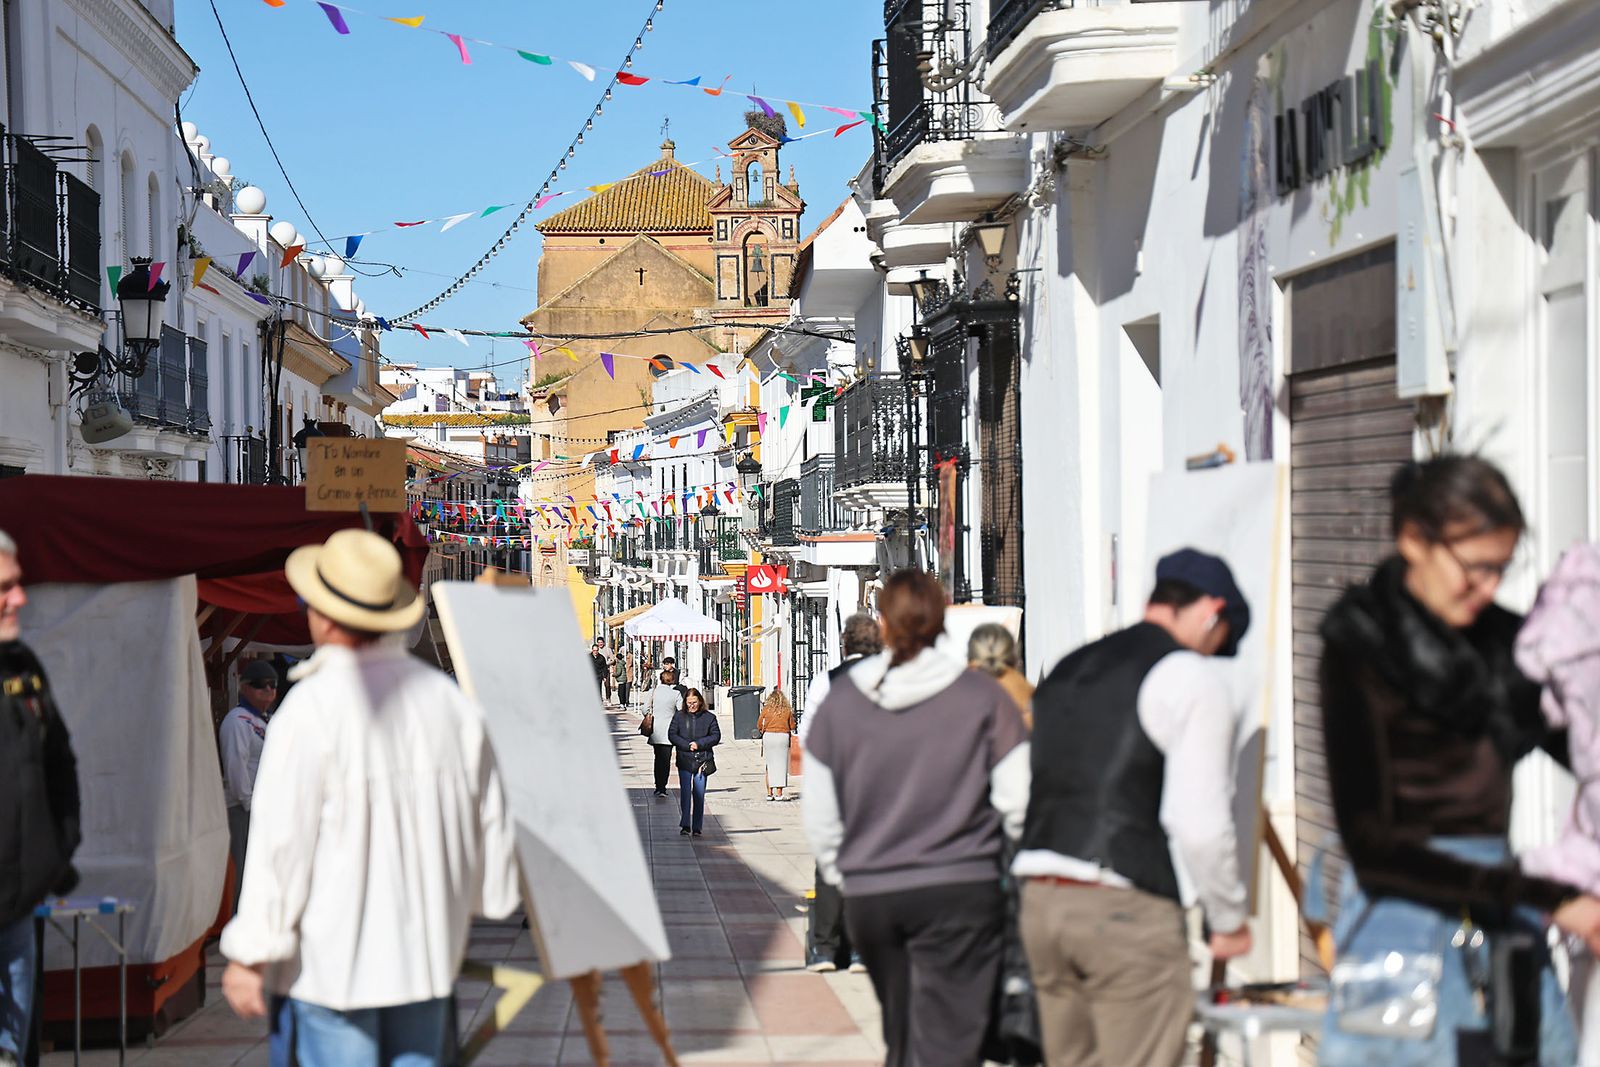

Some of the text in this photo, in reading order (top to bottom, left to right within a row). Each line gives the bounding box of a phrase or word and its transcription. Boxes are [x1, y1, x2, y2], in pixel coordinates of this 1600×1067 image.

[343, 445, 380, 459] Nombre
[335, 465, 363, 477] en un
